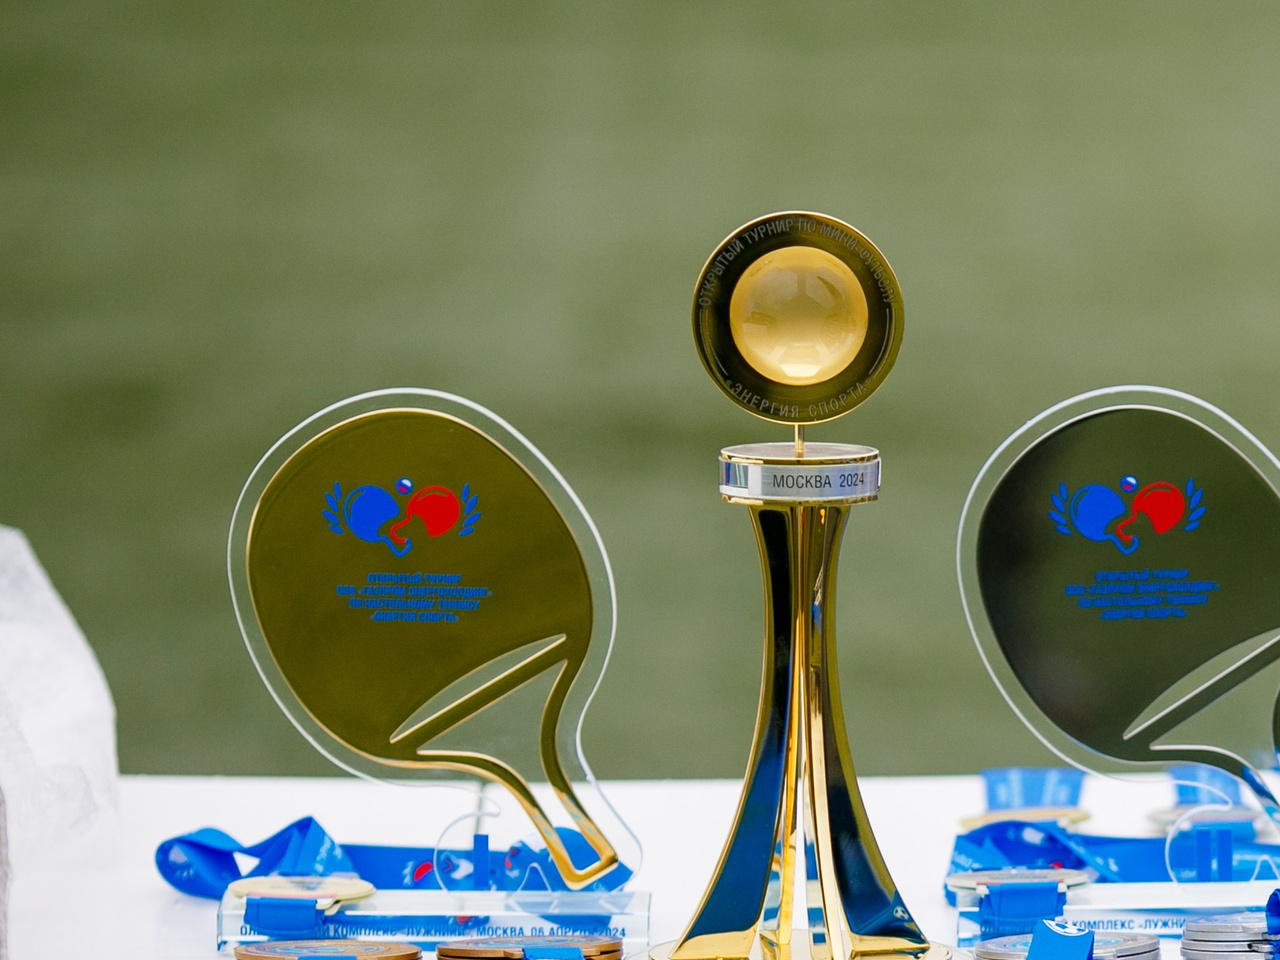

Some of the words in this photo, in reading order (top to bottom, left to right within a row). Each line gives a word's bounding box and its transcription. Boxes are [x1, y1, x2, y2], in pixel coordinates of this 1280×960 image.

[698, 237, 745, 306] ОТКРЫТЫЙ
[742, 218, 794, 245] ТУРНИР
[798, 218, 817, 233] ПО
[820, 222, 896, 304] МИНИ-ФУТБОЛУ
[725, 378, 800, 418] «ЭНЕРГИЯ
[808, 378, 872, 418] СПОРТА»
[773, 474, 832, 489] МОСКВА
[839, 472, 865, 488] 2024
